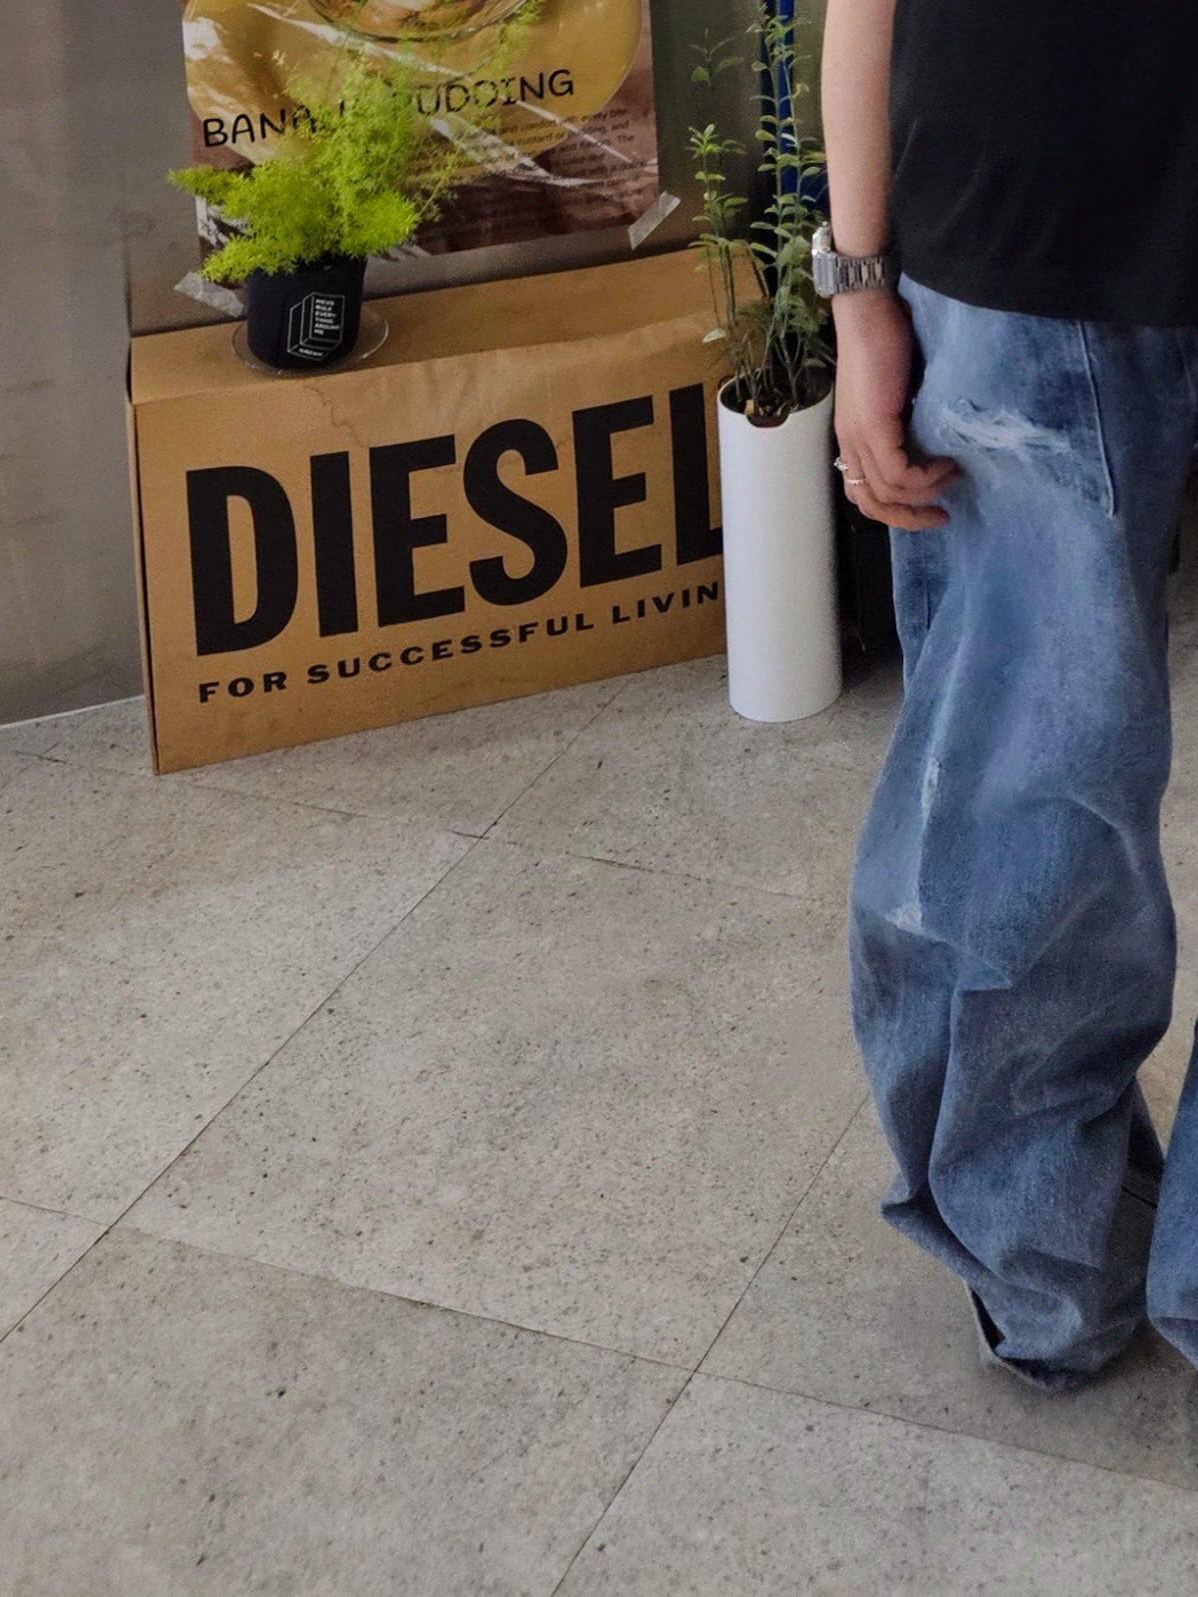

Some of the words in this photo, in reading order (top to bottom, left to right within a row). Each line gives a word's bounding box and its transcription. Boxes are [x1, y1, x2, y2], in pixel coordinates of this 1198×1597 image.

[202, 100, 345, 148] BANA
[400, 68, 575, 117] UDDING
[186, 382, 723, 657] DIESEL
[198, 670, 288, 703] FOR
[307, 612, 594, 685] SUCCESSFUL
[611, 581, 720, 625] LIVIN
